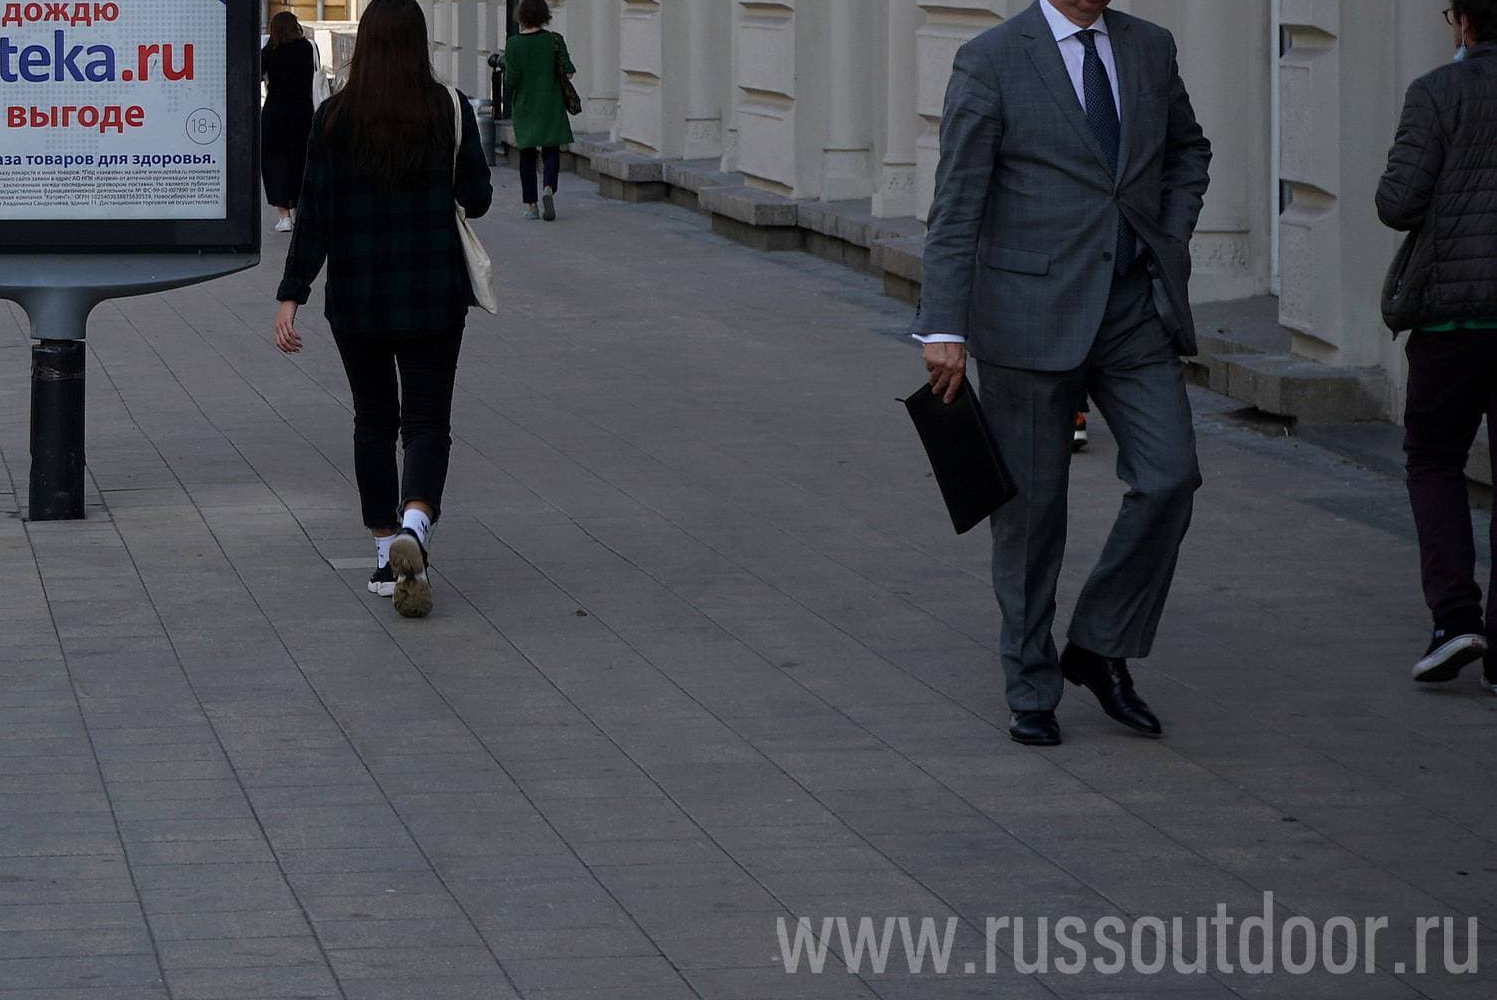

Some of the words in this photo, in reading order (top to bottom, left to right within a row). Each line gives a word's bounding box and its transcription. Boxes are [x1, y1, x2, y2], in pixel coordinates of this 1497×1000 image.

[2, 2, 119, 27] дождю
[7, 105, 145, 133] выгоде
[191, 119, 217, 133] 18+
[25, 154, 95, 168] товаров
[98, 154, 130, 168] для
[132, 153, 216, 168] здоровья.
